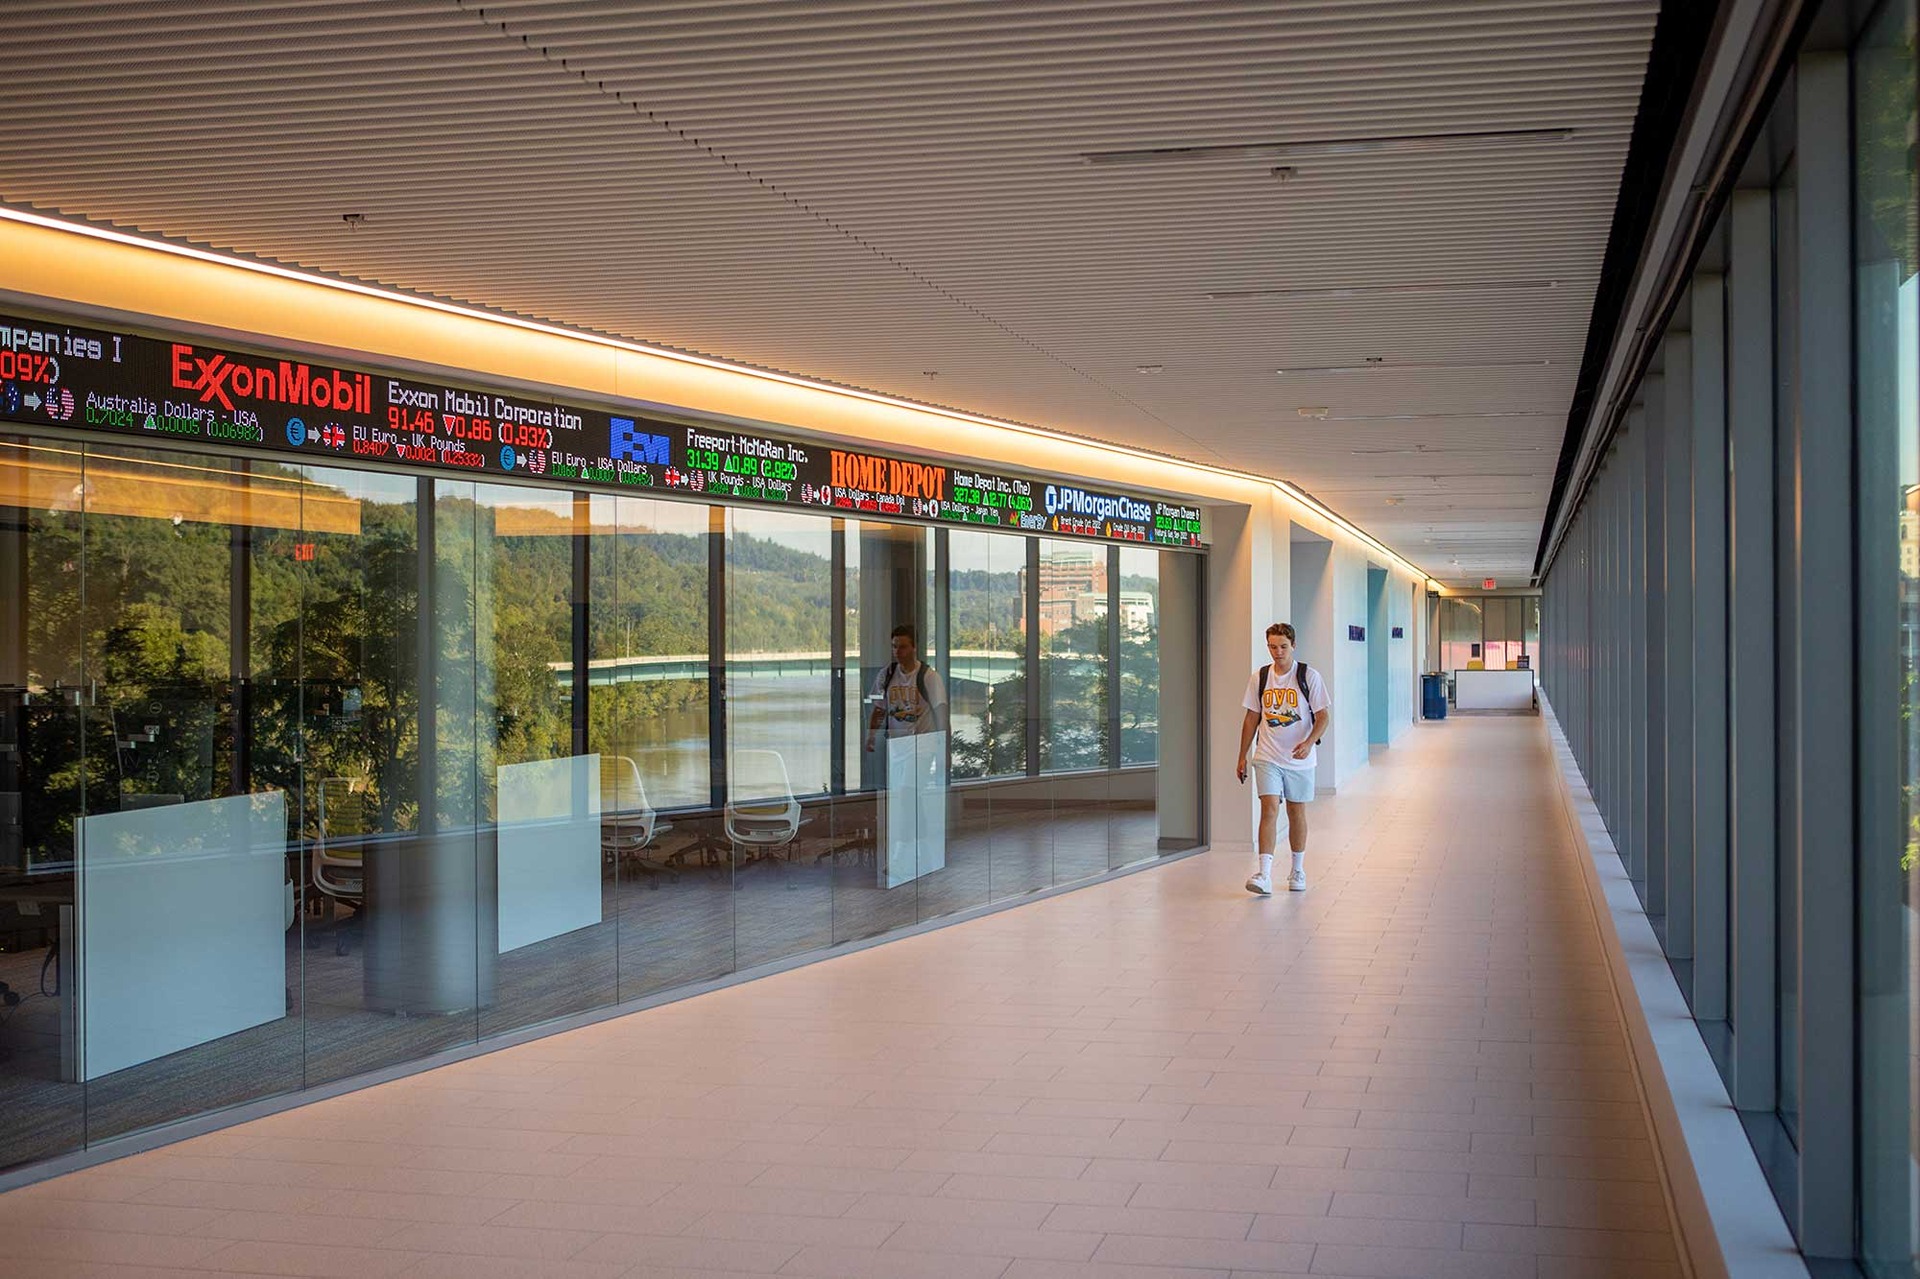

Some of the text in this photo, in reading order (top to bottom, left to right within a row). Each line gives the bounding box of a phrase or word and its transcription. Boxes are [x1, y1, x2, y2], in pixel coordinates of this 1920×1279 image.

[112, 335, 122, 363] I
[172, 343, 371, 415] ExxonMobil
[86, 390, 157, 416] Australia
[164, 400, 215, 422] Dollars
[233, 410, 259, 428] USA
[388, 380, 582, 431] Exxon Mobil Corporation
[85, 406, 264, 442] 0.7024 0.0005 (0.0698%)
[387, 405, 553, 450] 91.46 0.86 (0.93%)
[353, 425, 367, 441] EU
[372, 427, 398, 445] Euro
[412, 433, 426, 448] UK
[431, 435, 466, 453] Pounds
[687, 427, 809, 463] Freeport-McMoRan Inc.
[352, 440, 485, 467] 0.8407 0.0021 (0.2533%)
[551, 451, 563, 465] EU
[566, 453, 587, 468] Euro
[597, 456, 615, 471] USA
[617, 459, 648, 475] Dollars
[686, 448, 798, 480] 31.39 0.89 (2.92%)
[707, 470, 717, 483] UK
[720, 472, 744, 486] Pounds
[752, 475, 766, 489] USA
[767, 478, 792, 492] Dollars
[830, 449, 946, 501] HOME DEPOT
[953, 470, 1031, 496] Home Depot Inc. (The)
[834, 487, 847, 499] USA
[848, 487, 870, 501] Dollars
[876, 492, 895, 504] Canada
[940, 501, 951, 511] USA
[953, 486, 980, 505] 327.38
[1057, 487, 1152, 522] JPMorganChase
[1020, 510, 1048, 530] Energy
[295, 543, 315, 561] EXIT
[1262, 688, 1298, 709] OVO
